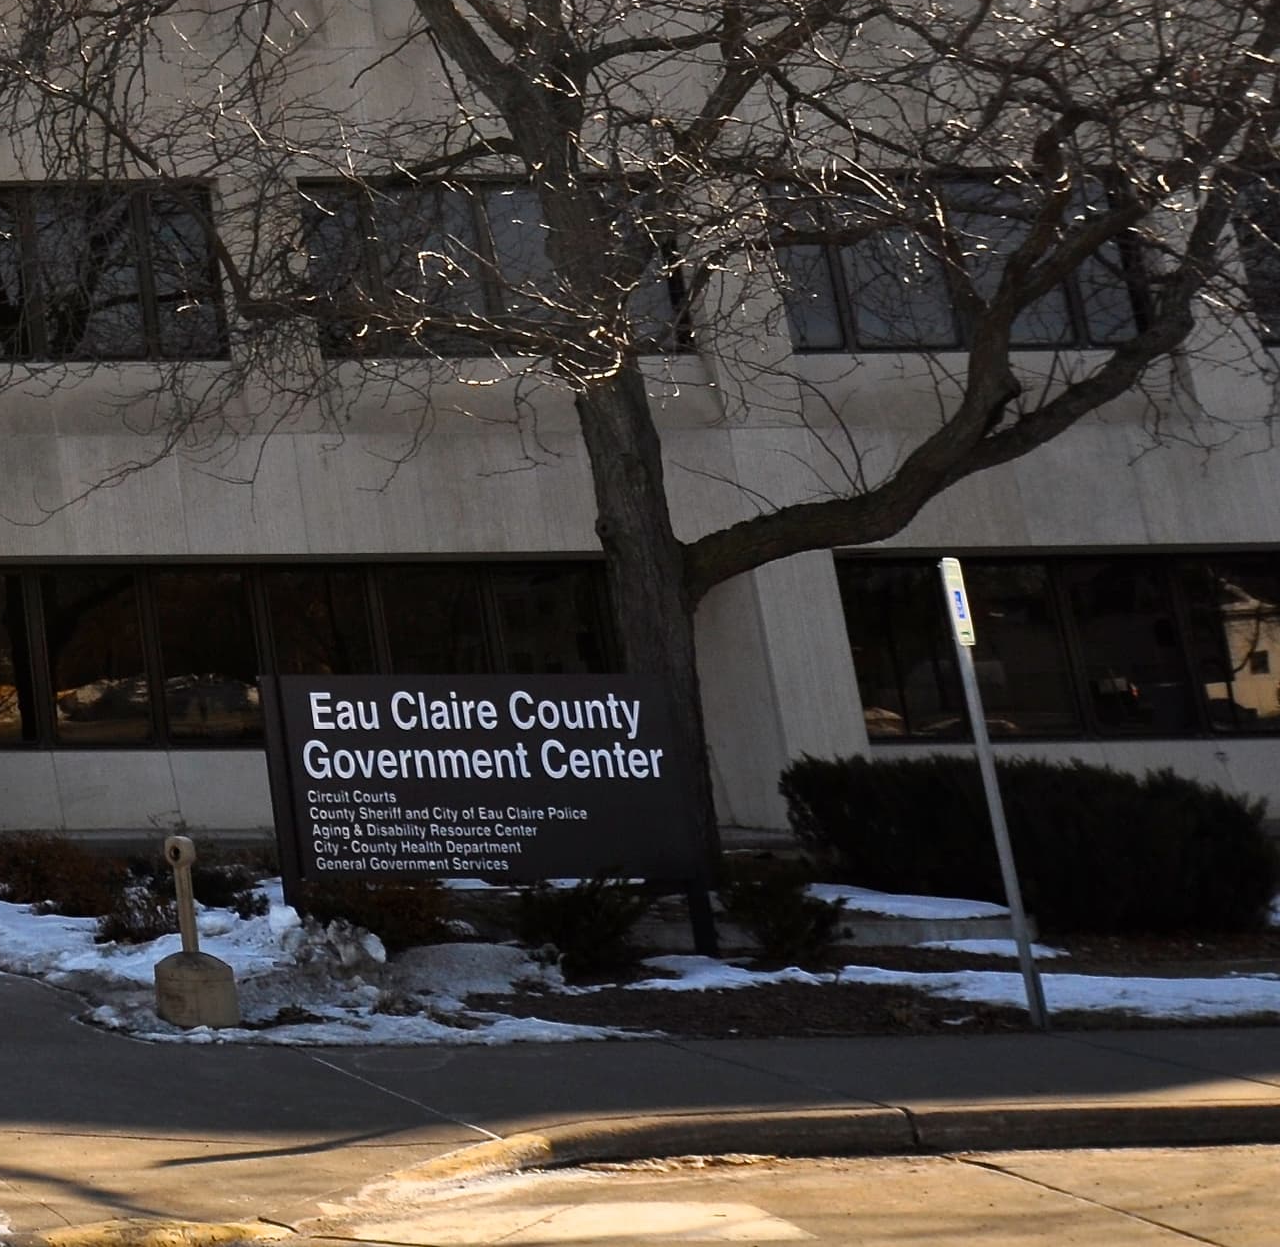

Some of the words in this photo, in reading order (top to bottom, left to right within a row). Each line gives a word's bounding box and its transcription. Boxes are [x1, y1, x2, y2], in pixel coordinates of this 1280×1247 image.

[309, 692, 380, 730] Eau
[391, 691, 498, 730] Claire
[509, 690, 640, 739] County
[302, 739, 531, 779] Government
[541, 739, 663, 779] Center
[307, 790, 350, 803] Circuit
[353, 790, 397, 803] Courts
[310, 807, 355, 822] County
[359, 807, 401, 819] Sheriff
[405, 808, 429, 819] and
[433, 807, 458, 822] City
[462, 807, 475, 820] of
[478, 807, 504, 820] Eau
[506, 807, 544, 820] Claire
[547, 807, 588, 820] Police
[312, 824, 351, 839] Aging
[354, 824, 363, 836] &
[366, 824, 426, 839] Disability
[430, 824, 492, 836] Resource
[495, 823, 538, 836] Center
[314, 840, 339, 856] City
[351, 840, 397, 856] County
[401, 840, 442, 853] Health
[446, 840, 522, 856] Department
[316, 857, 366, 870] General
[370, 857, 449, 870] Government
[452, 857, 509, 870] Services
